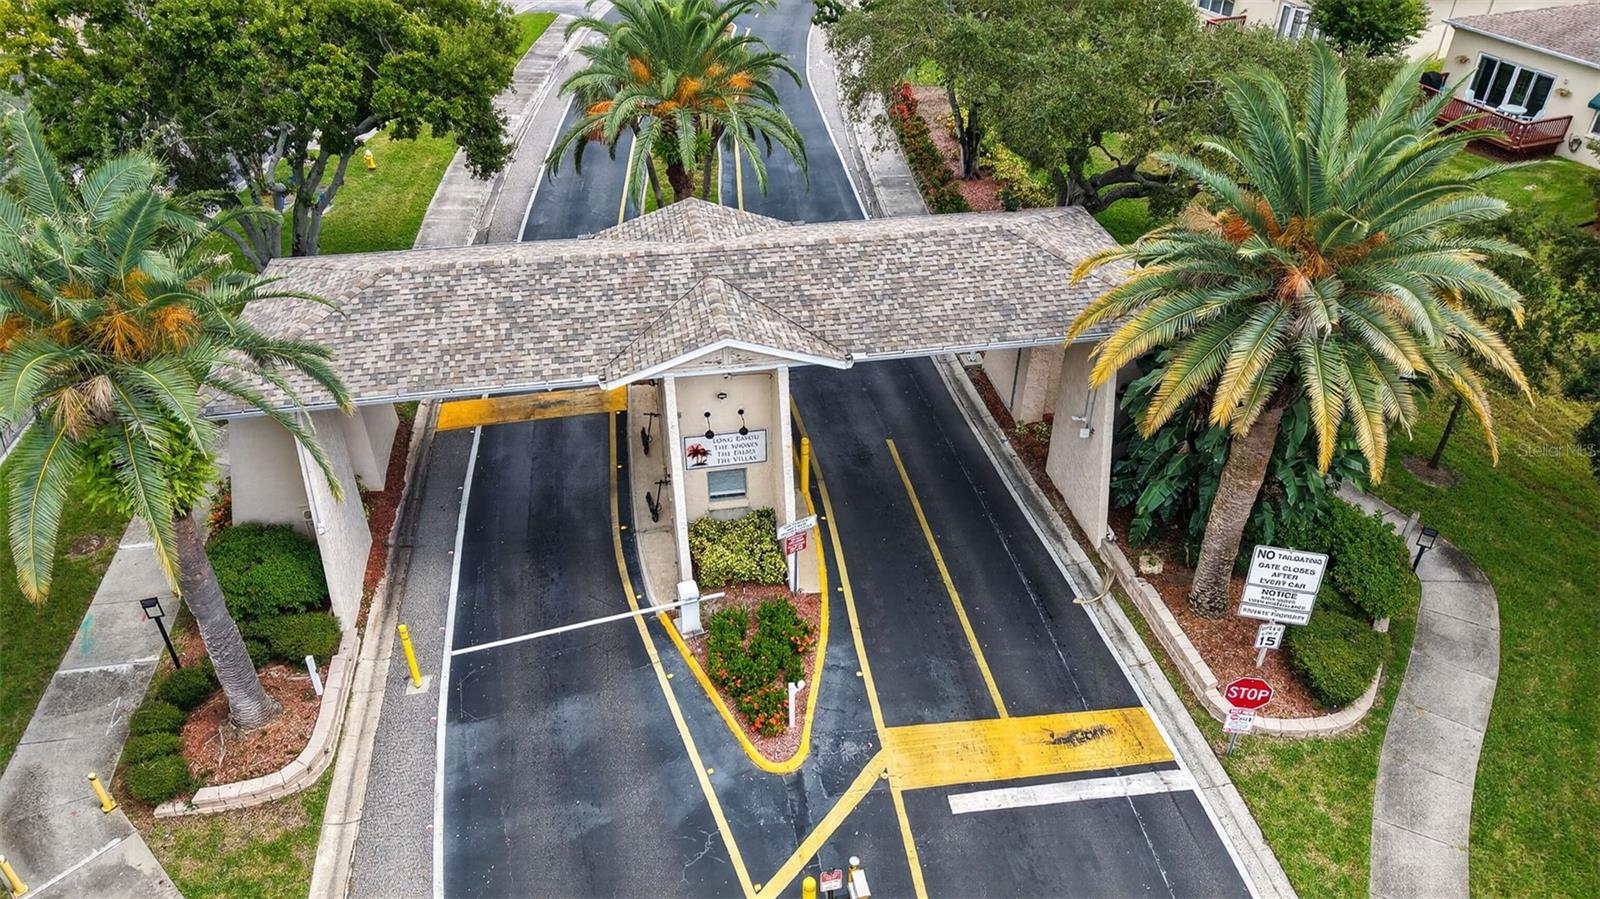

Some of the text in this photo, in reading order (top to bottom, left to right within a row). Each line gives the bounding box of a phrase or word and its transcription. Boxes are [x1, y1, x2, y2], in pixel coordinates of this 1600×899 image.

[1257, 549, 1322, 565] NO TAILGATING
[1258, 562, 1316, 575] GATE CLOSES
[1271, 572, 1298, 580] AFTER
[1259, 577, 1306, 589] EVERY CAR
[1261, 589, 1298, 600] NOTICE
[1242, 607, 1269, 616] PRIVATE
[1260, 636, 1276, 646] 15
[1227, 686, 1269, 701] STOP
